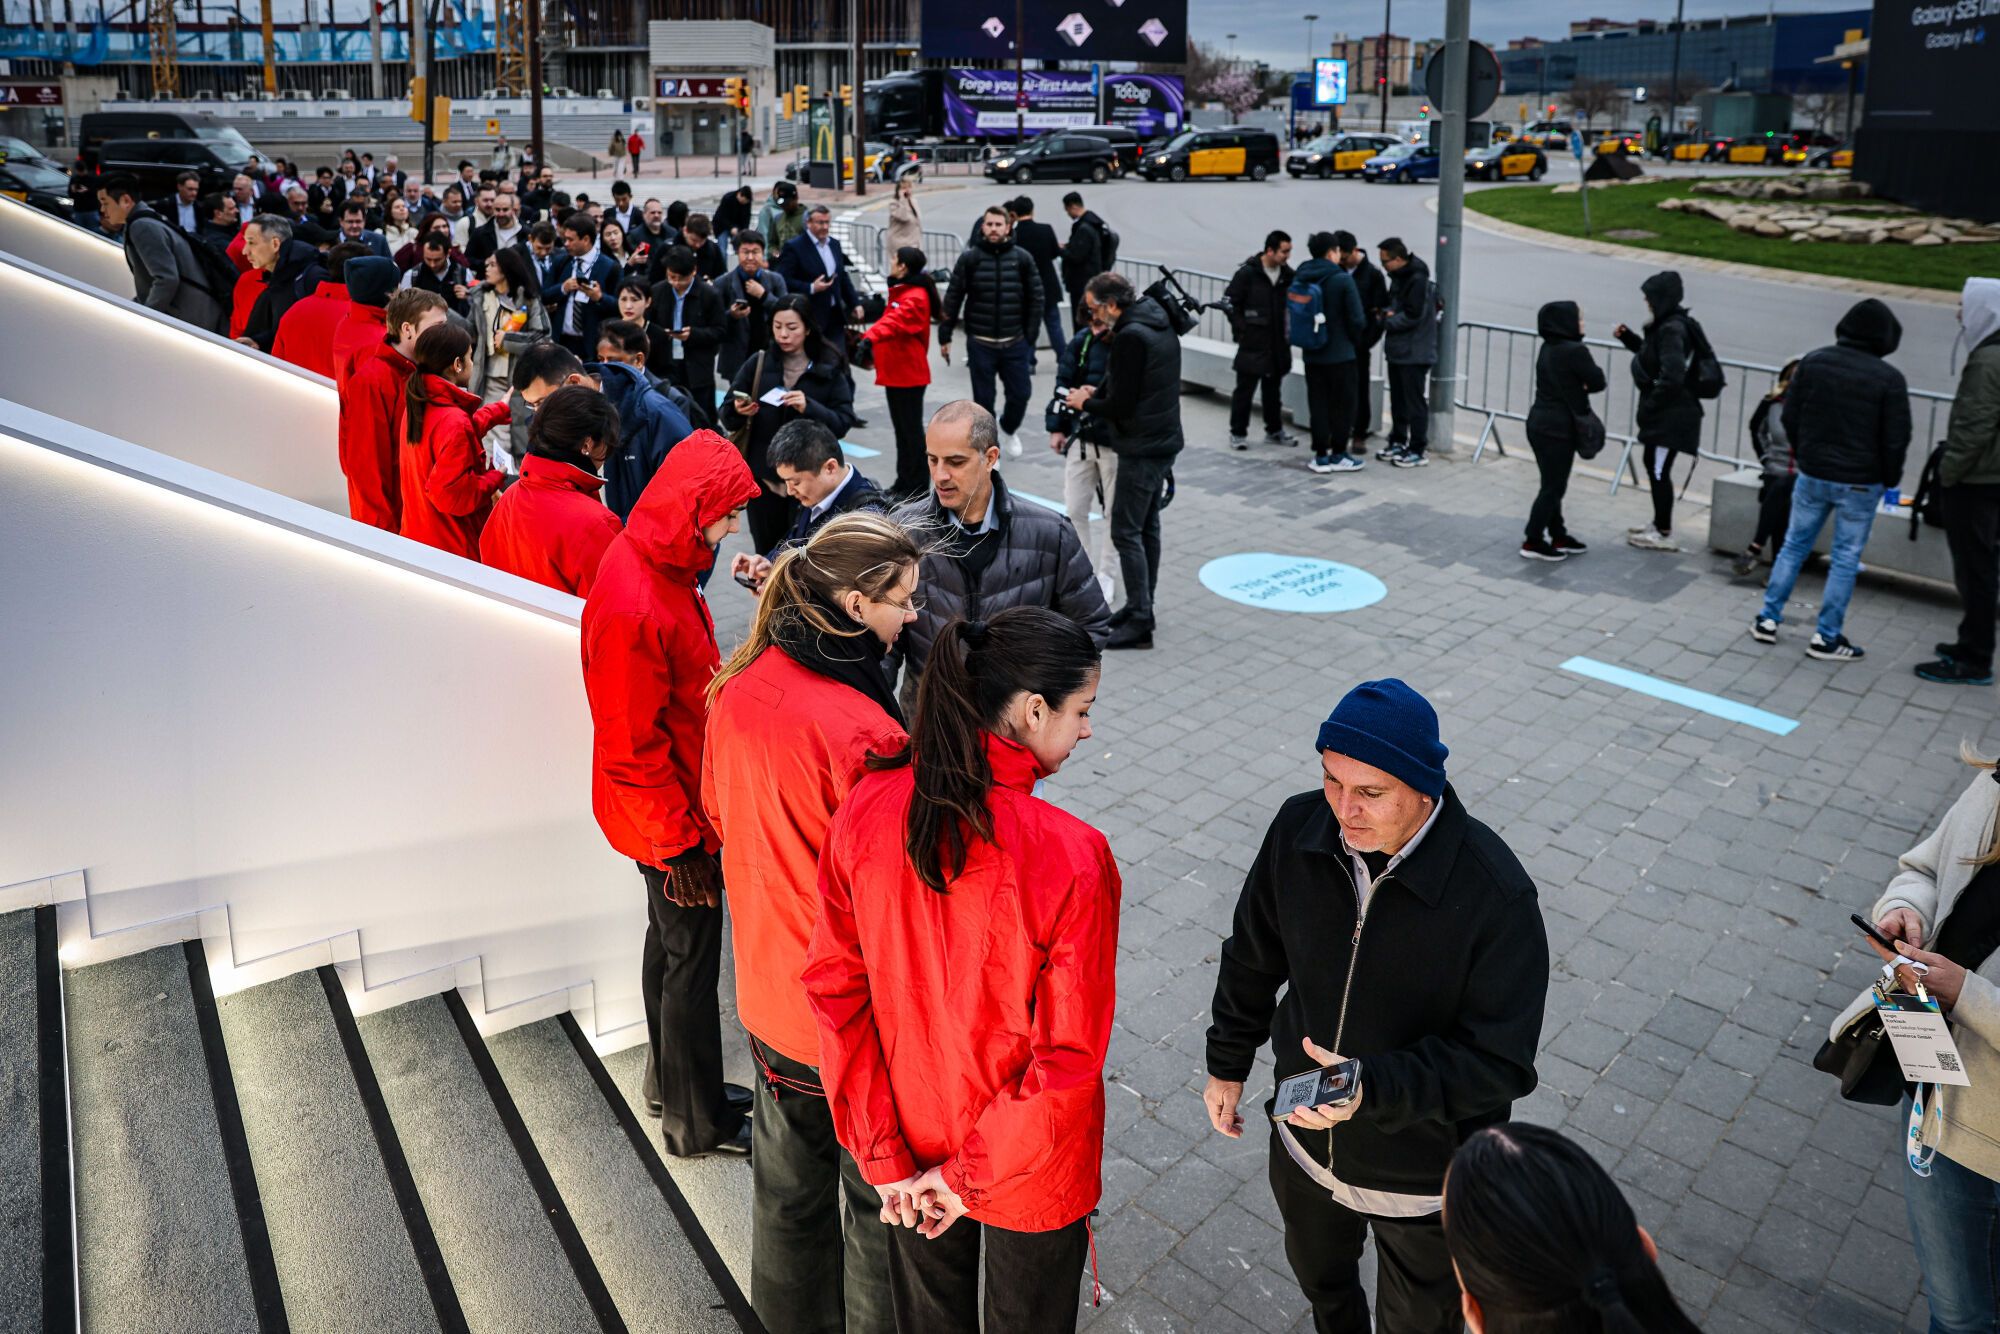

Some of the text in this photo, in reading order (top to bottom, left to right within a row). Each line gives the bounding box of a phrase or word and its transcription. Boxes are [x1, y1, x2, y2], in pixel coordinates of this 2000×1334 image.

[1911, 6, 1953, 26] Galaxy
[1955, 0, 1978, 19] S25
[1925, 32, 1962, 49] Galaxy
[664, 79, 692, 97] P A
[959, 78, 990, 94] Forge
[993, 79, 1018, 94] you
[7, 87, 19, 103] A
